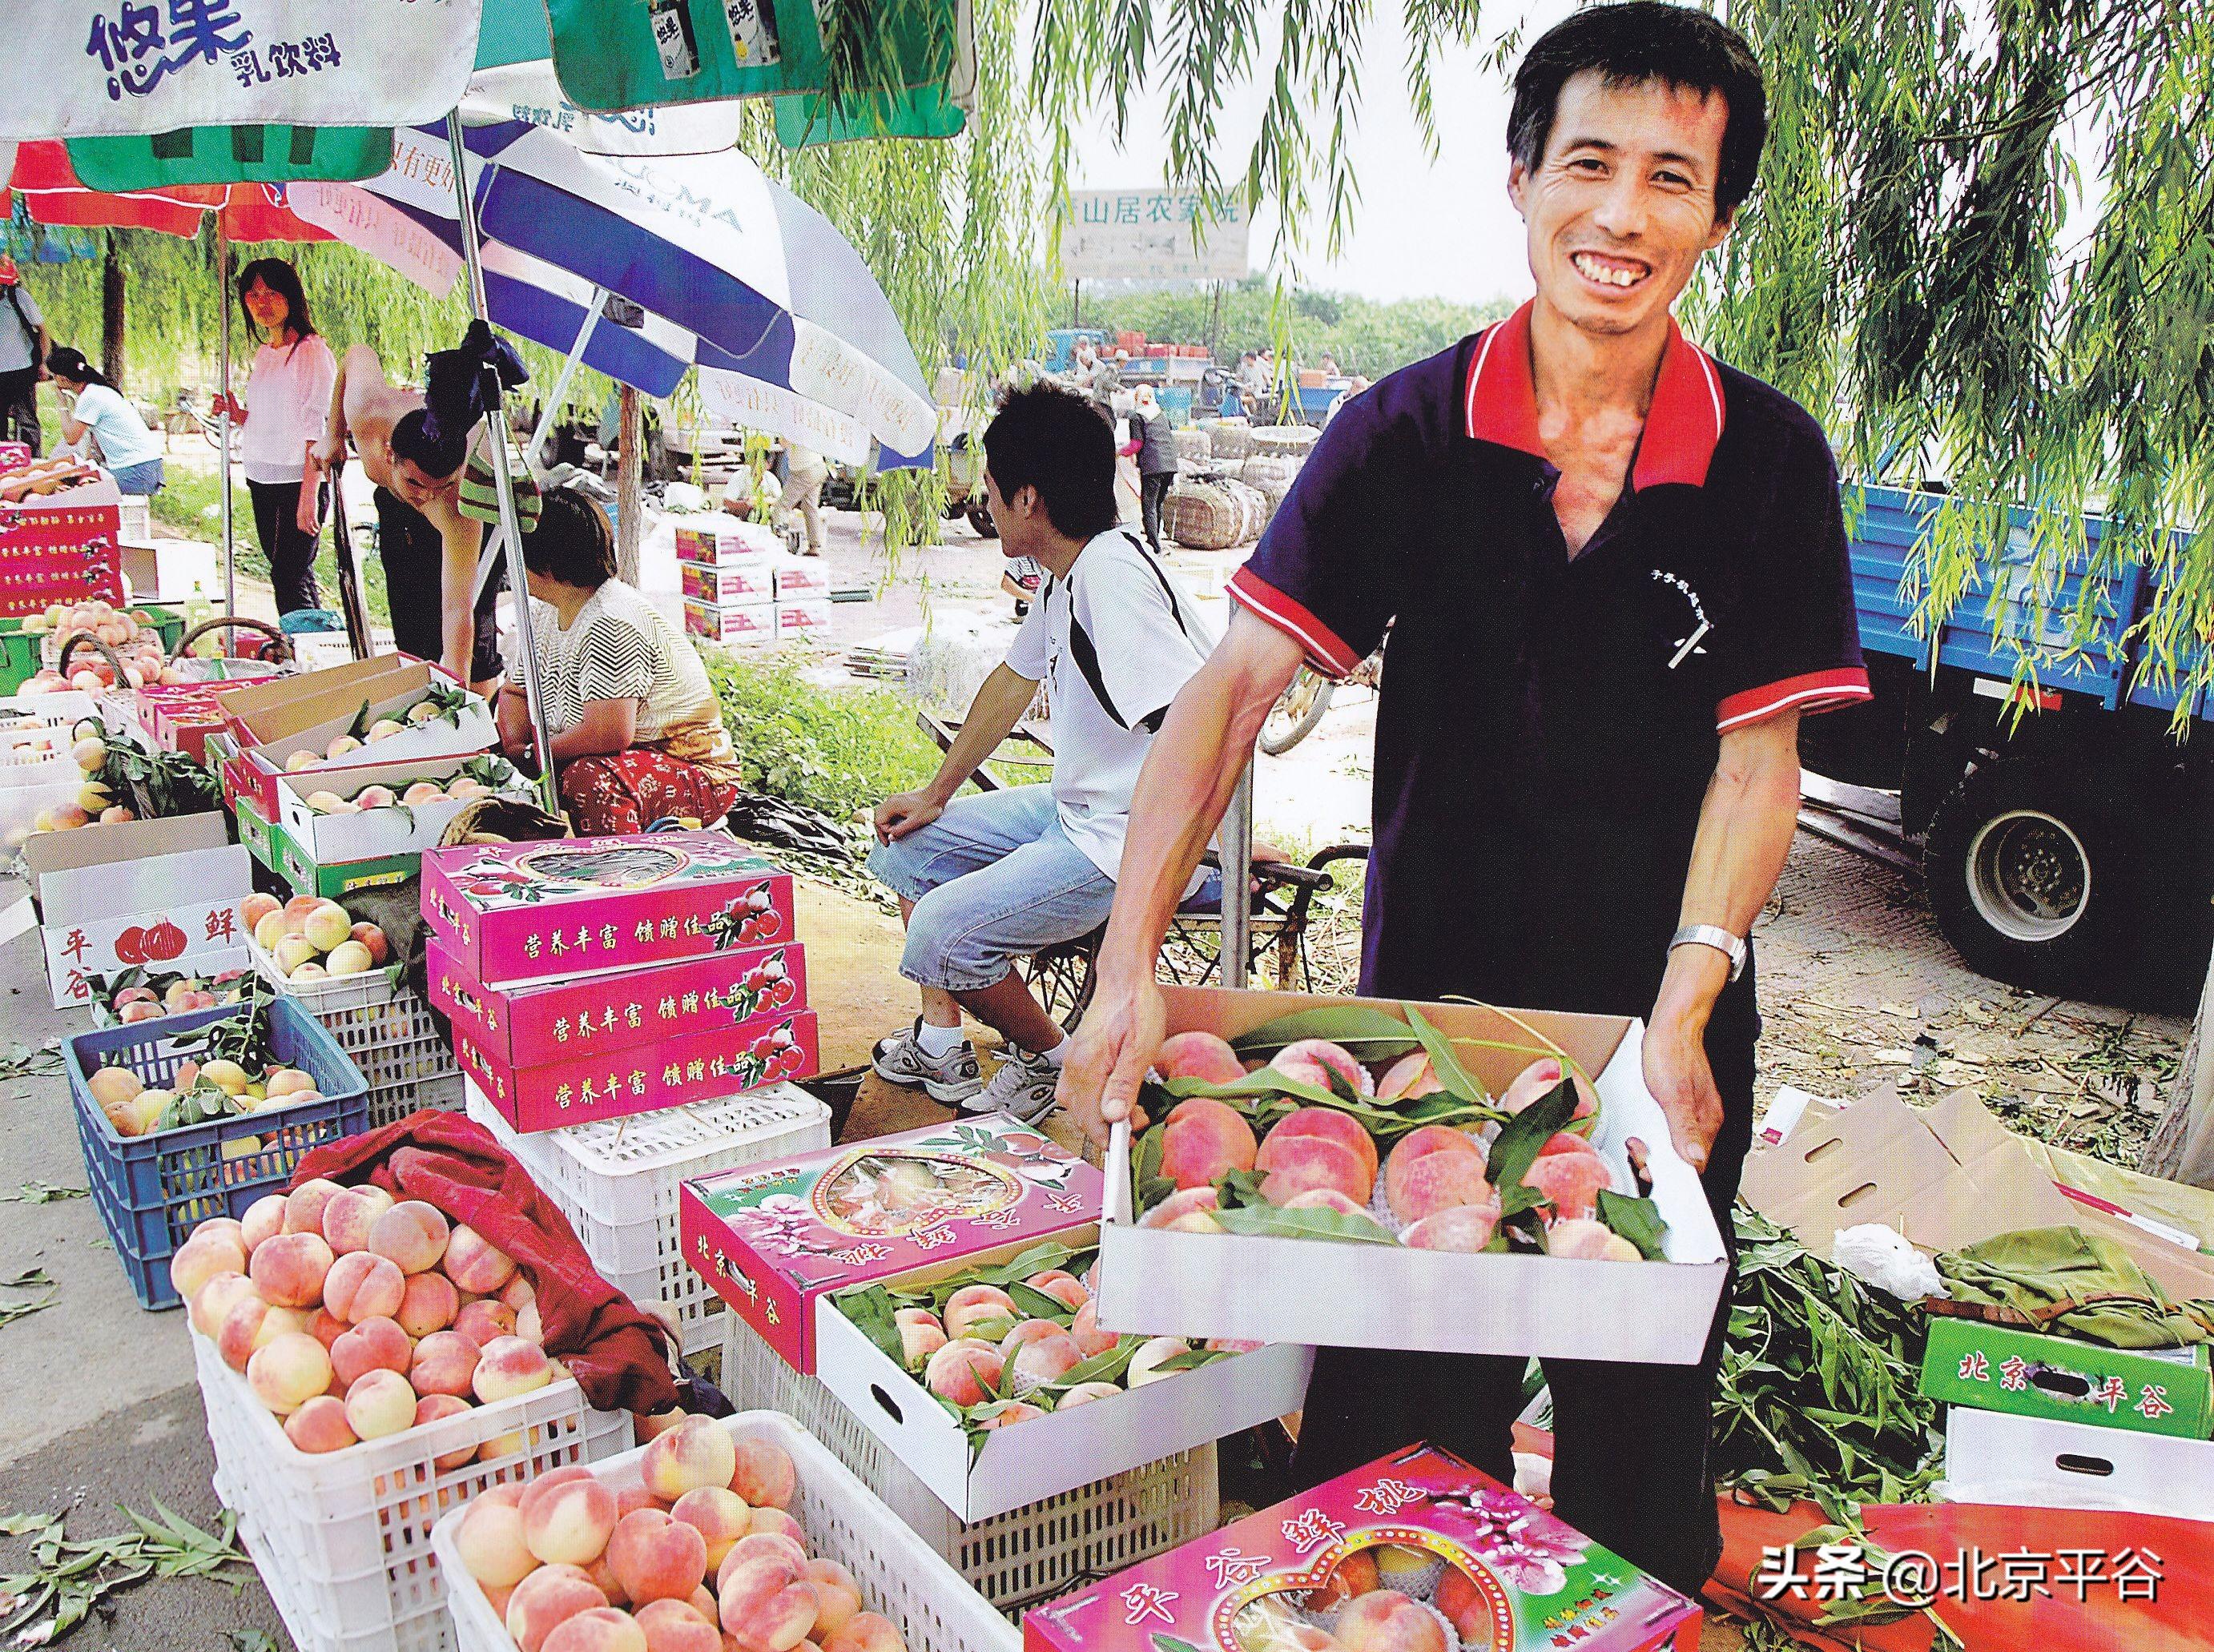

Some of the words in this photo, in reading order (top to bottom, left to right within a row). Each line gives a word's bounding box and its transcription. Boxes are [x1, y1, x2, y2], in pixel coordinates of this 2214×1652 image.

[230, 32, 342, 88] 乳饮料
[205, 907, 237, 944] 鲜
[523, 925, 618, 959] 营养丰富
[634, 912, 728, 945] 馈赠佳品
[553, 1003, 644, 1043] 营养丰富
[658, 982, 745, 1021] 馈赠佳品
[554, 1069, 647, 1110] 营养丰富
[662, 1051, 755, 1086] 馈赠佳品
